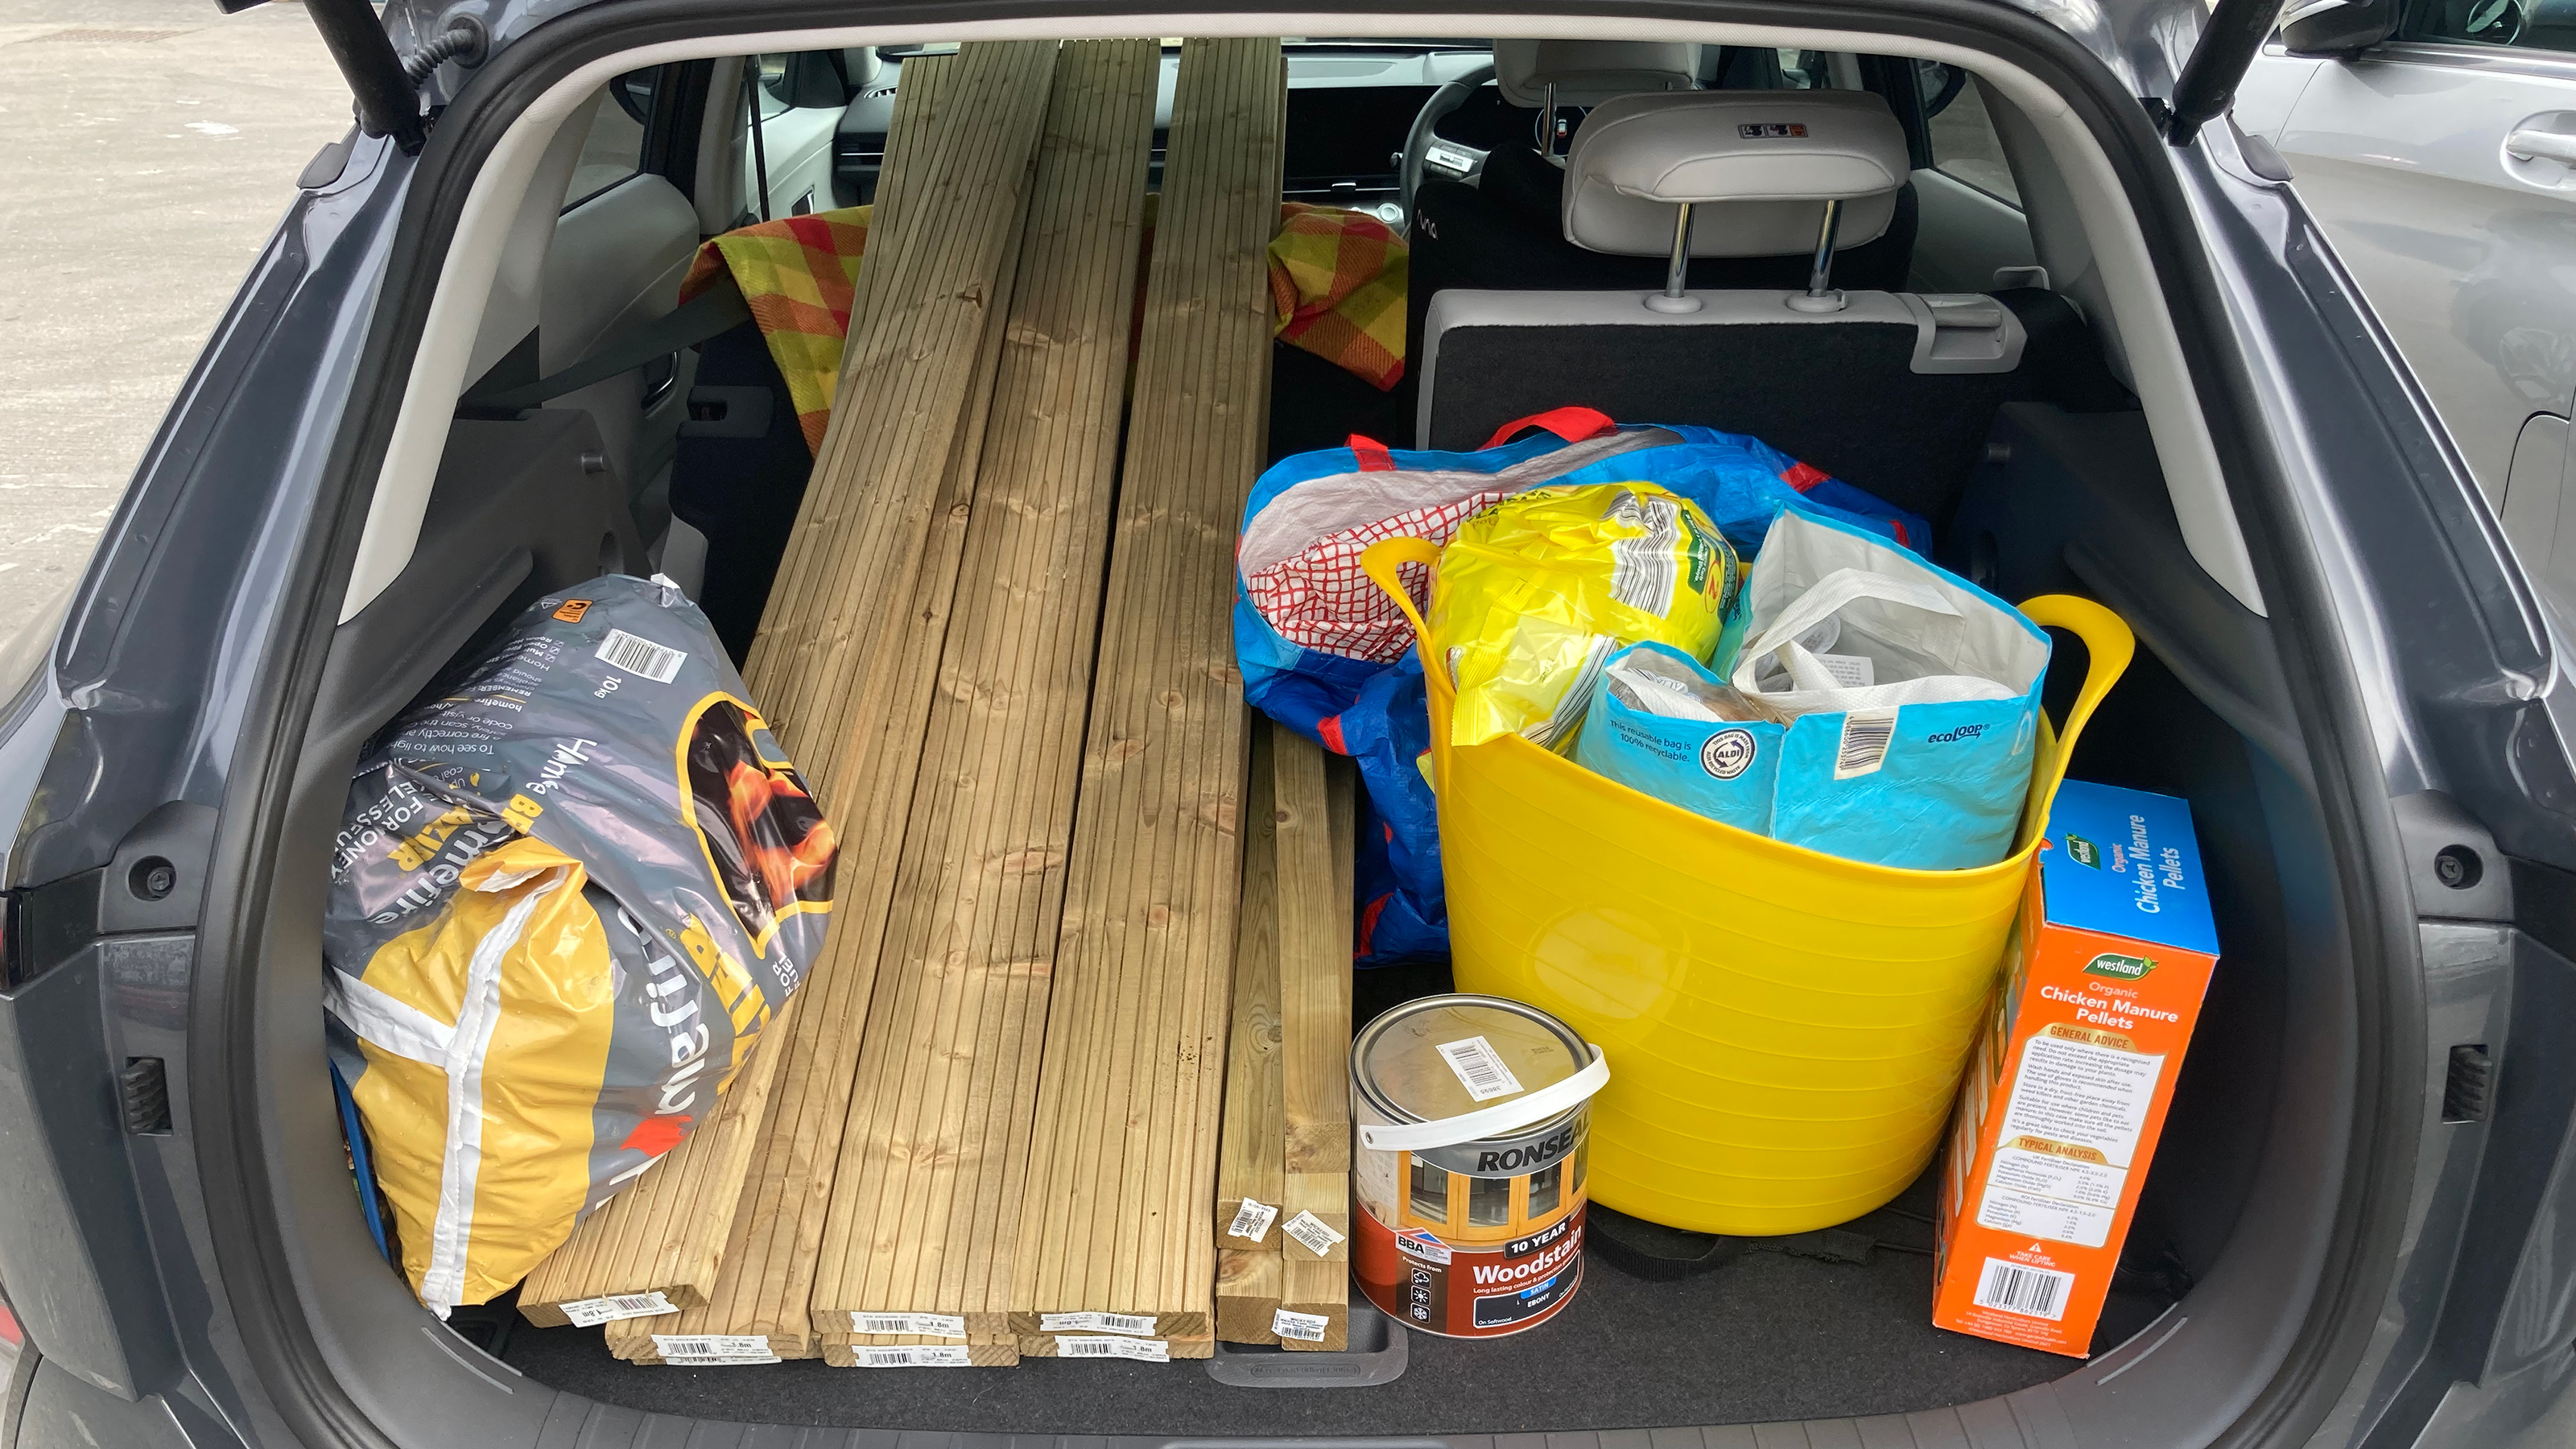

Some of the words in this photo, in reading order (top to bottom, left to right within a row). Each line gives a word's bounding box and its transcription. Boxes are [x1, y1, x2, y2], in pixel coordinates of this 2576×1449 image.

[417, 729, 469, 739] correctly
[1610, 720, 1626, 732] This
[1627, 727, 1662, 745] reusable
[1664, 738, 1682, 750] bag
[1684, 741, 1691, 750] is
[1712, 737, 1724, 745] THIS
[414, 742, 427, 752] to
[428, 744, 455, 754] how
[456, 743, 477, 753] see
[478, 744, 493, 754] To
[1620, 733, 1644, 748] 100%
[1645, 744, 1690, 762] recyclable.
[1717, 749, 1740, 758] ALDI
[381, 797, 424, 832] FOR
[2128, 815, 2152, 861] Manure
[2073, 840, 2091, 863] westland
[2109, 843, 2128, 873] Organic
[2158, 847, 2186, 890] Pellets
[2132, 863, 2161, 913] Chicken
[772, 961, 794, 997] FOR
[779, 951, 801, 990] FUEL
[2096, 960, 2143, 976] westland
[2088, 981, 2139, 999] Organic
[2041, 985, 2107, 1009] Chicken
[2112, 999, 2178, 1022] Manure
[2075, 1008, 2133, 1030] Pellets
[2050, 1026, 2091, 1042] GENERAL
[2095, 1034, 2129, 1049] ADVICE
[1477, 1110, 1590, 1172] RONSEAL
[2018, 1137, 2054, 1153] TYPICAL
[2055, 1146, 2097, 1161] ANALYSIS
[1398, 1236, 1425, 1254] BBA
[1511, 1242, 1528, 1253] 10
[1530, 1222, 1567, 1247] YEAR
[1402, 1256, 1426, 1269] Protects
[1426, 1265, 1442, 1273] from
[1472, 1225, 1582, 1285] Woodstain
[2008, 1253, 2031, 1262] WHEN
[2029, 1257, 2056, 1267] LIFTING
[2015, 1250, 2033, 1258] TAKE
[2033, 1253, 2051, 1262] CARE
[1491, 1284, 1513, 1294] lasting
[1513, 1280, 1532, 1290] colour
[1538, 1263, 1562, 1282] protection
[1530, 1282, 1550, 1294] SATIN
[1527, 1292, 1550, 1308] EBONY
[1488, 1316, 1513, 1325] Softwood
